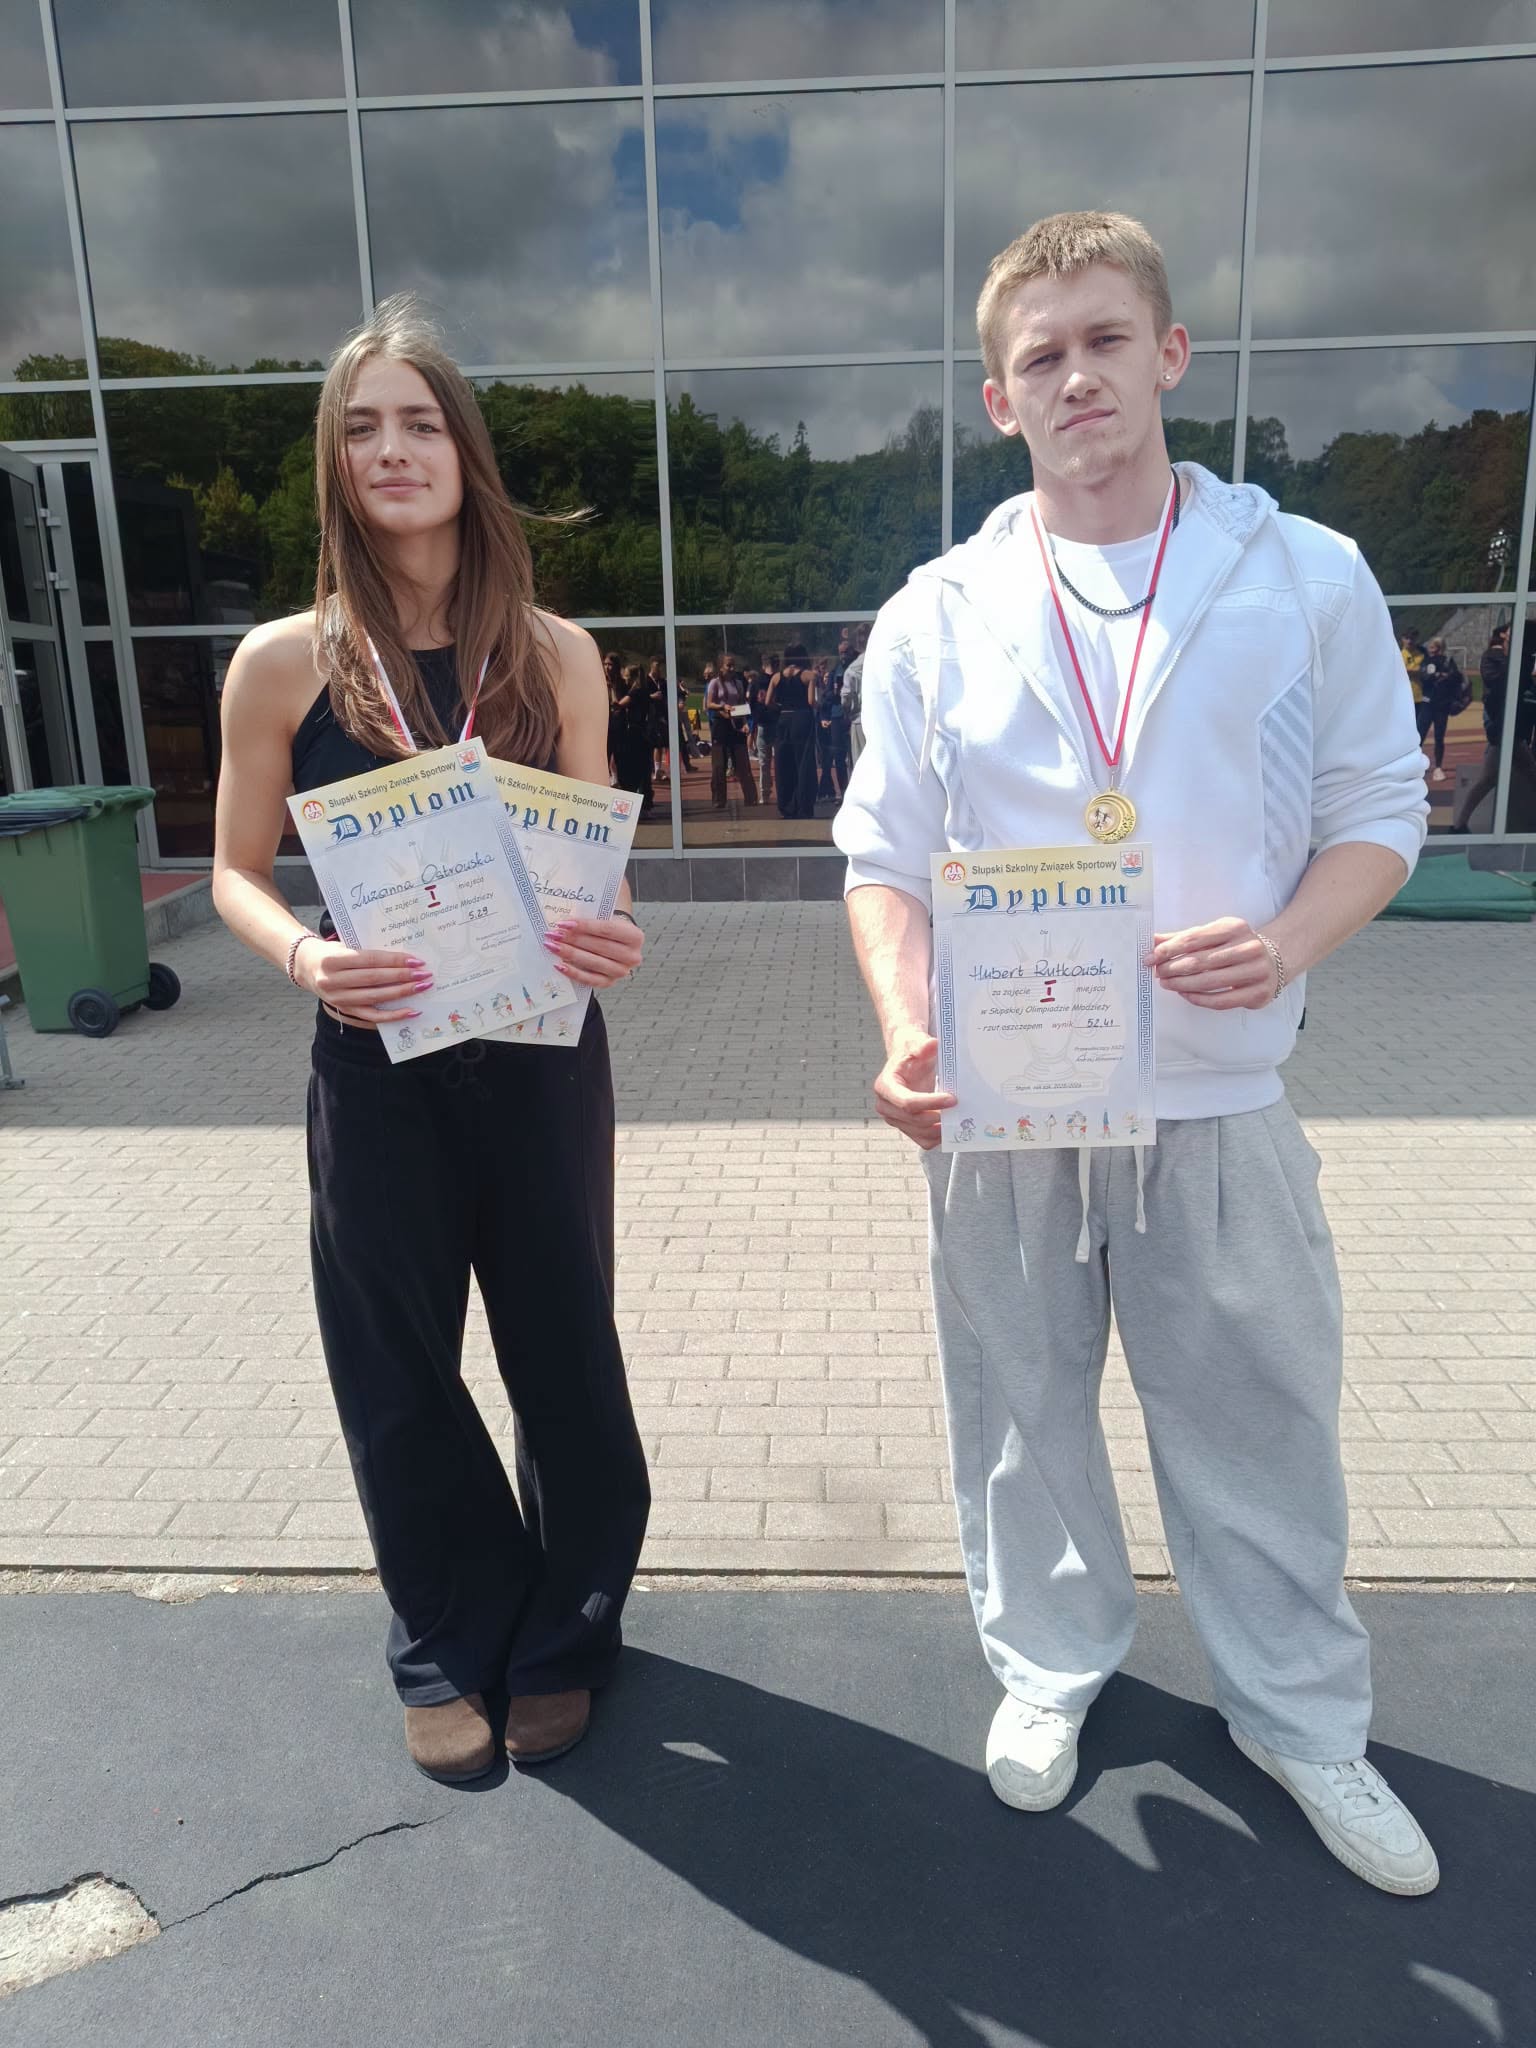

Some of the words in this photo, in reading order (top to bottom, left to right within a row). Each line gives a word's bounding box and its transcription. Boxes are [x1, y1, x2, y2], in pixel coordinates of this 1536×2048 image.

[357, 784, 389, 798] Szkolny
[388, 774, 421, 789] Związek
[420, 760, 457, 780] Sportowy
[506, 776, 541, 795] Szkolny
[571, 794, 609, 813] Sportowy
[327, 782, 475, 844] Dyplom
[503, 800, 612, 843] yplom
[946, 873, 963, 882] SZS
[971, 863, 1004, 876] Słupski
[1005, 862, 1038, 875] Szkolny
[1040, 859, 1074, 874] Związek
[1077, 858, 1117, 872] Sportowy
[964, 880, 1127, 914] Dyplom
[1040, 980, 1057, 1003] I
